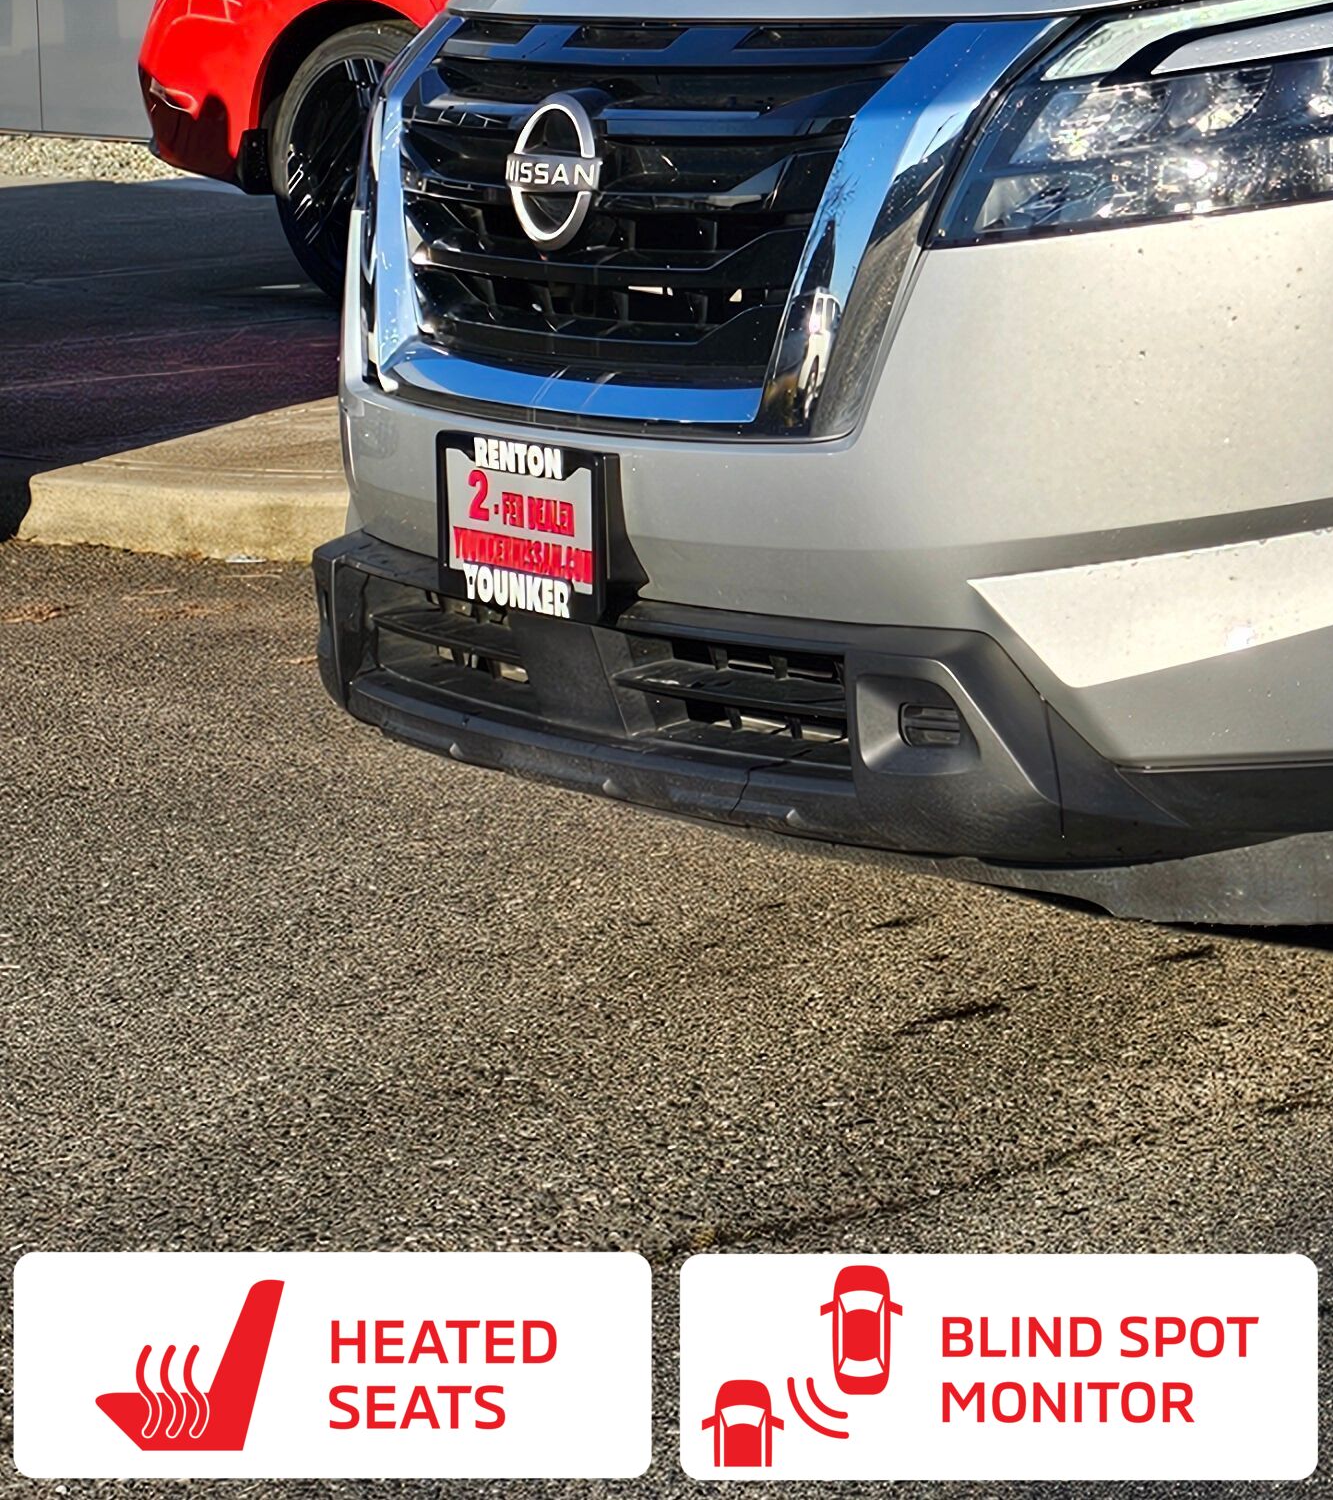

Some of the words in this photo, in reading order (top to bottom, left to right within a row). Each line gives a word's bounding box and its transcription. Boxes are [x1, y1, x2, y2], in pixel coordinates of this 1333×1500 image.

[505, 159, 595, 187] NISSAN
[473, 436, 563, 480] RENTON
[462, 562, 570, 619] YOUNKER
